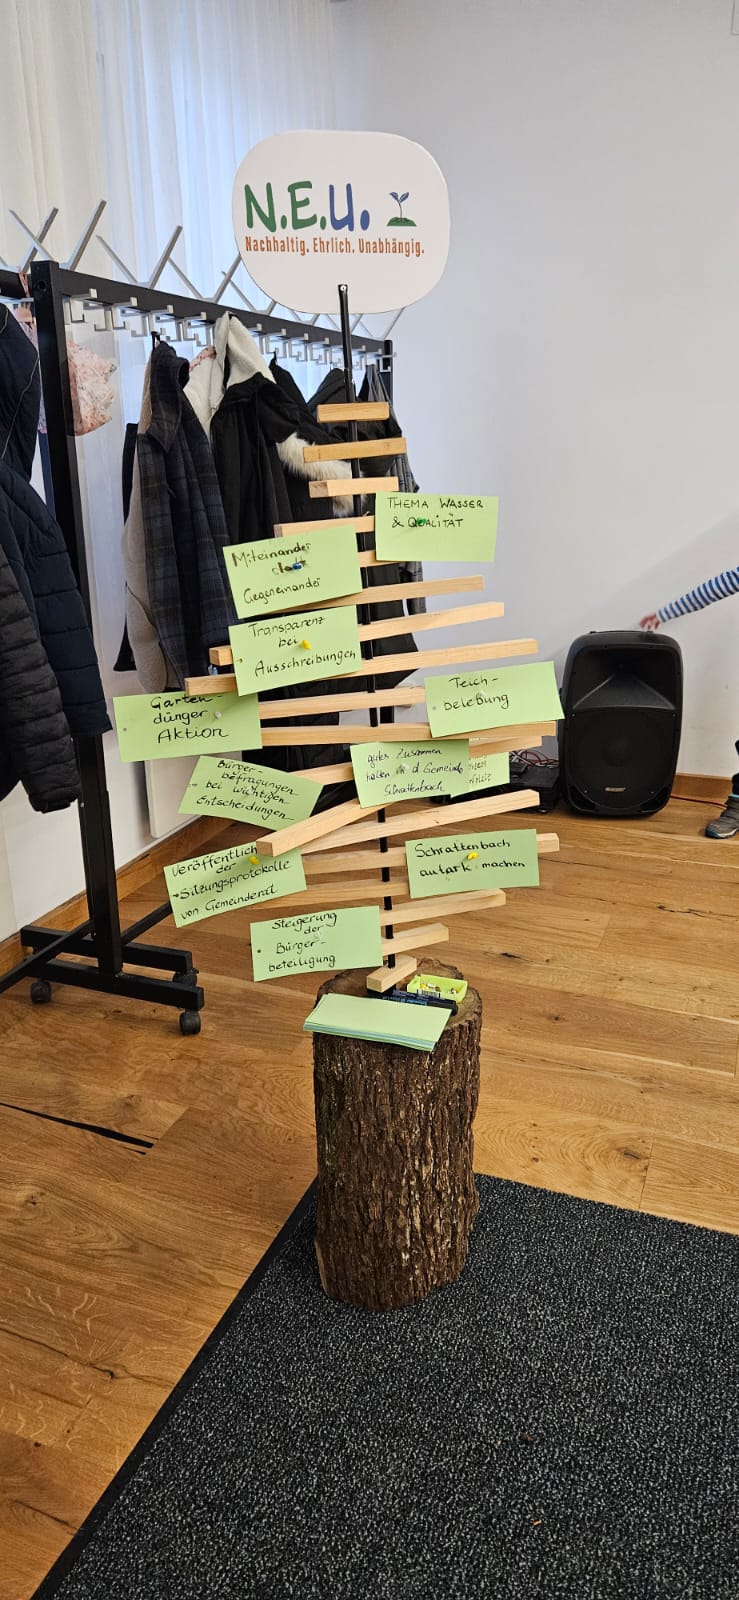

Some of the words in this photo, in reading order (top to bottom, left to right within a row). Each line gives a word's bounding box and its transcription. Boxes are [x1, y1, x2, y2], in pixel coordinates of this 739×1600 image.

[244, 180, 370, 232] N.E.U.
[245, 236, 309, 256] Nachhaltig.
[313, 237, 355, 253] Ehrlich.
[358, 238, 425, 257] Unabhängig.
[388, 497, 428, 509] THEMA
[440, 498, 483, 508] WASSER
[392, 516, 404, 528] &
[231, 542, 311, 568] Miteinander
[243, 577, 320, 604] Gegeneinander
[248, 616, 325, 637] Transparenz
[278, 635, 298, 648] bei
[254, 650, 356, 677] Ausschreibungen
[153, 709, 208, 725] dünger
[158, 727, 229, 743] Aktion
[206, 780, 222, 790] bei
[196, 795, 295, 820] Entscheidungen
[415, 839, 511, 858] Schrattenbach
[216, 862, 236, 874] der
[420, 862, 472, 877] autark
[481, 860, 525, 869] machen
[180, 859, 290, 899] Sitzungsprotokolle
[181, 907, 198, 919] von
[272, 912, 338, 932] Steigerung
[304, 924, 323, 935] der
[268, 955, 336, 972] beteiligung
